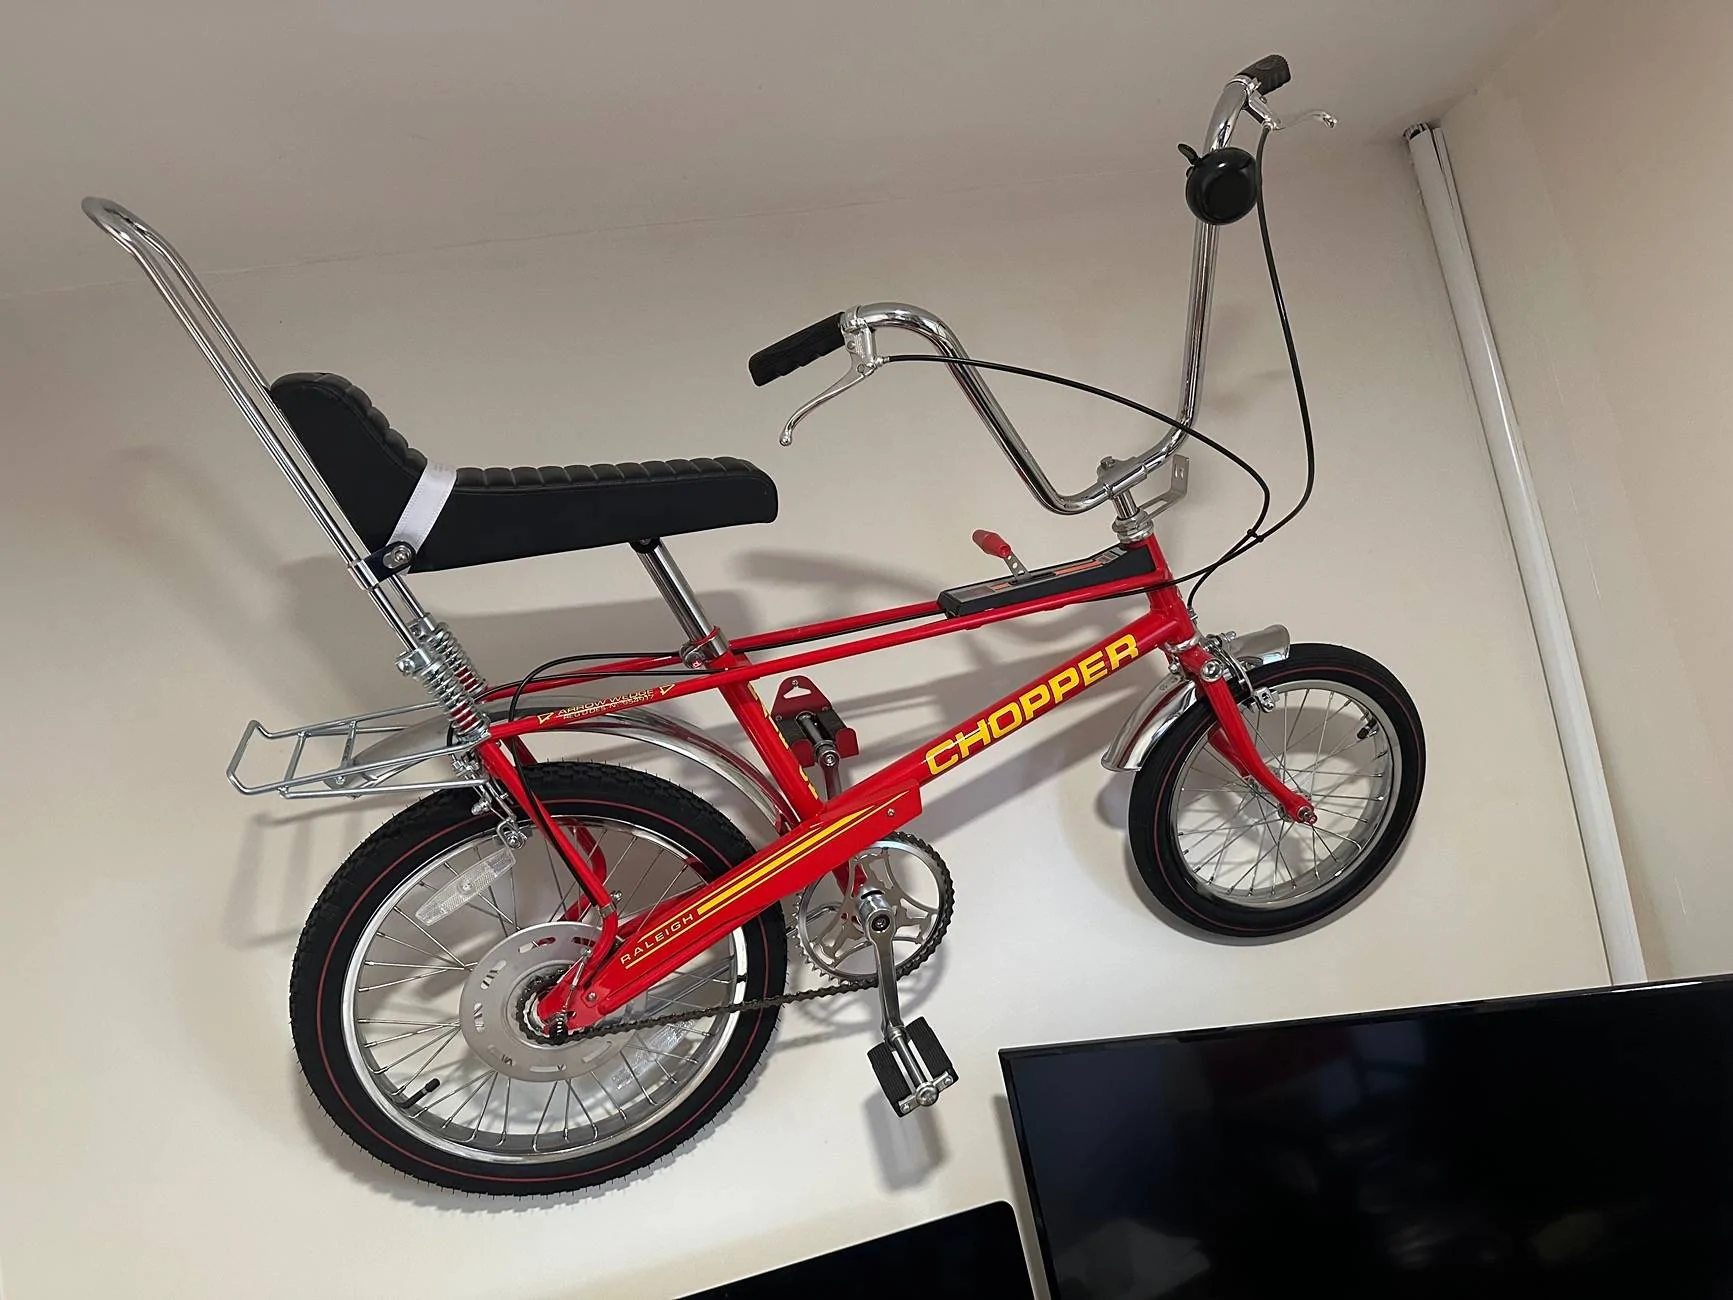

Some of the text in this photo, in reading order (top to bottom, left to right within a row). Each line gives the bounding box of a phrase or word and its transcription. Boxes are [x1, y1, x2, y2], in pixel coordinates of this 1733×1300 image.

[557, 699, 606, 715] ARROW
[925, 633, 1139, 775] CHOPPER
[620, 913, 694, 964] RALEIGH
